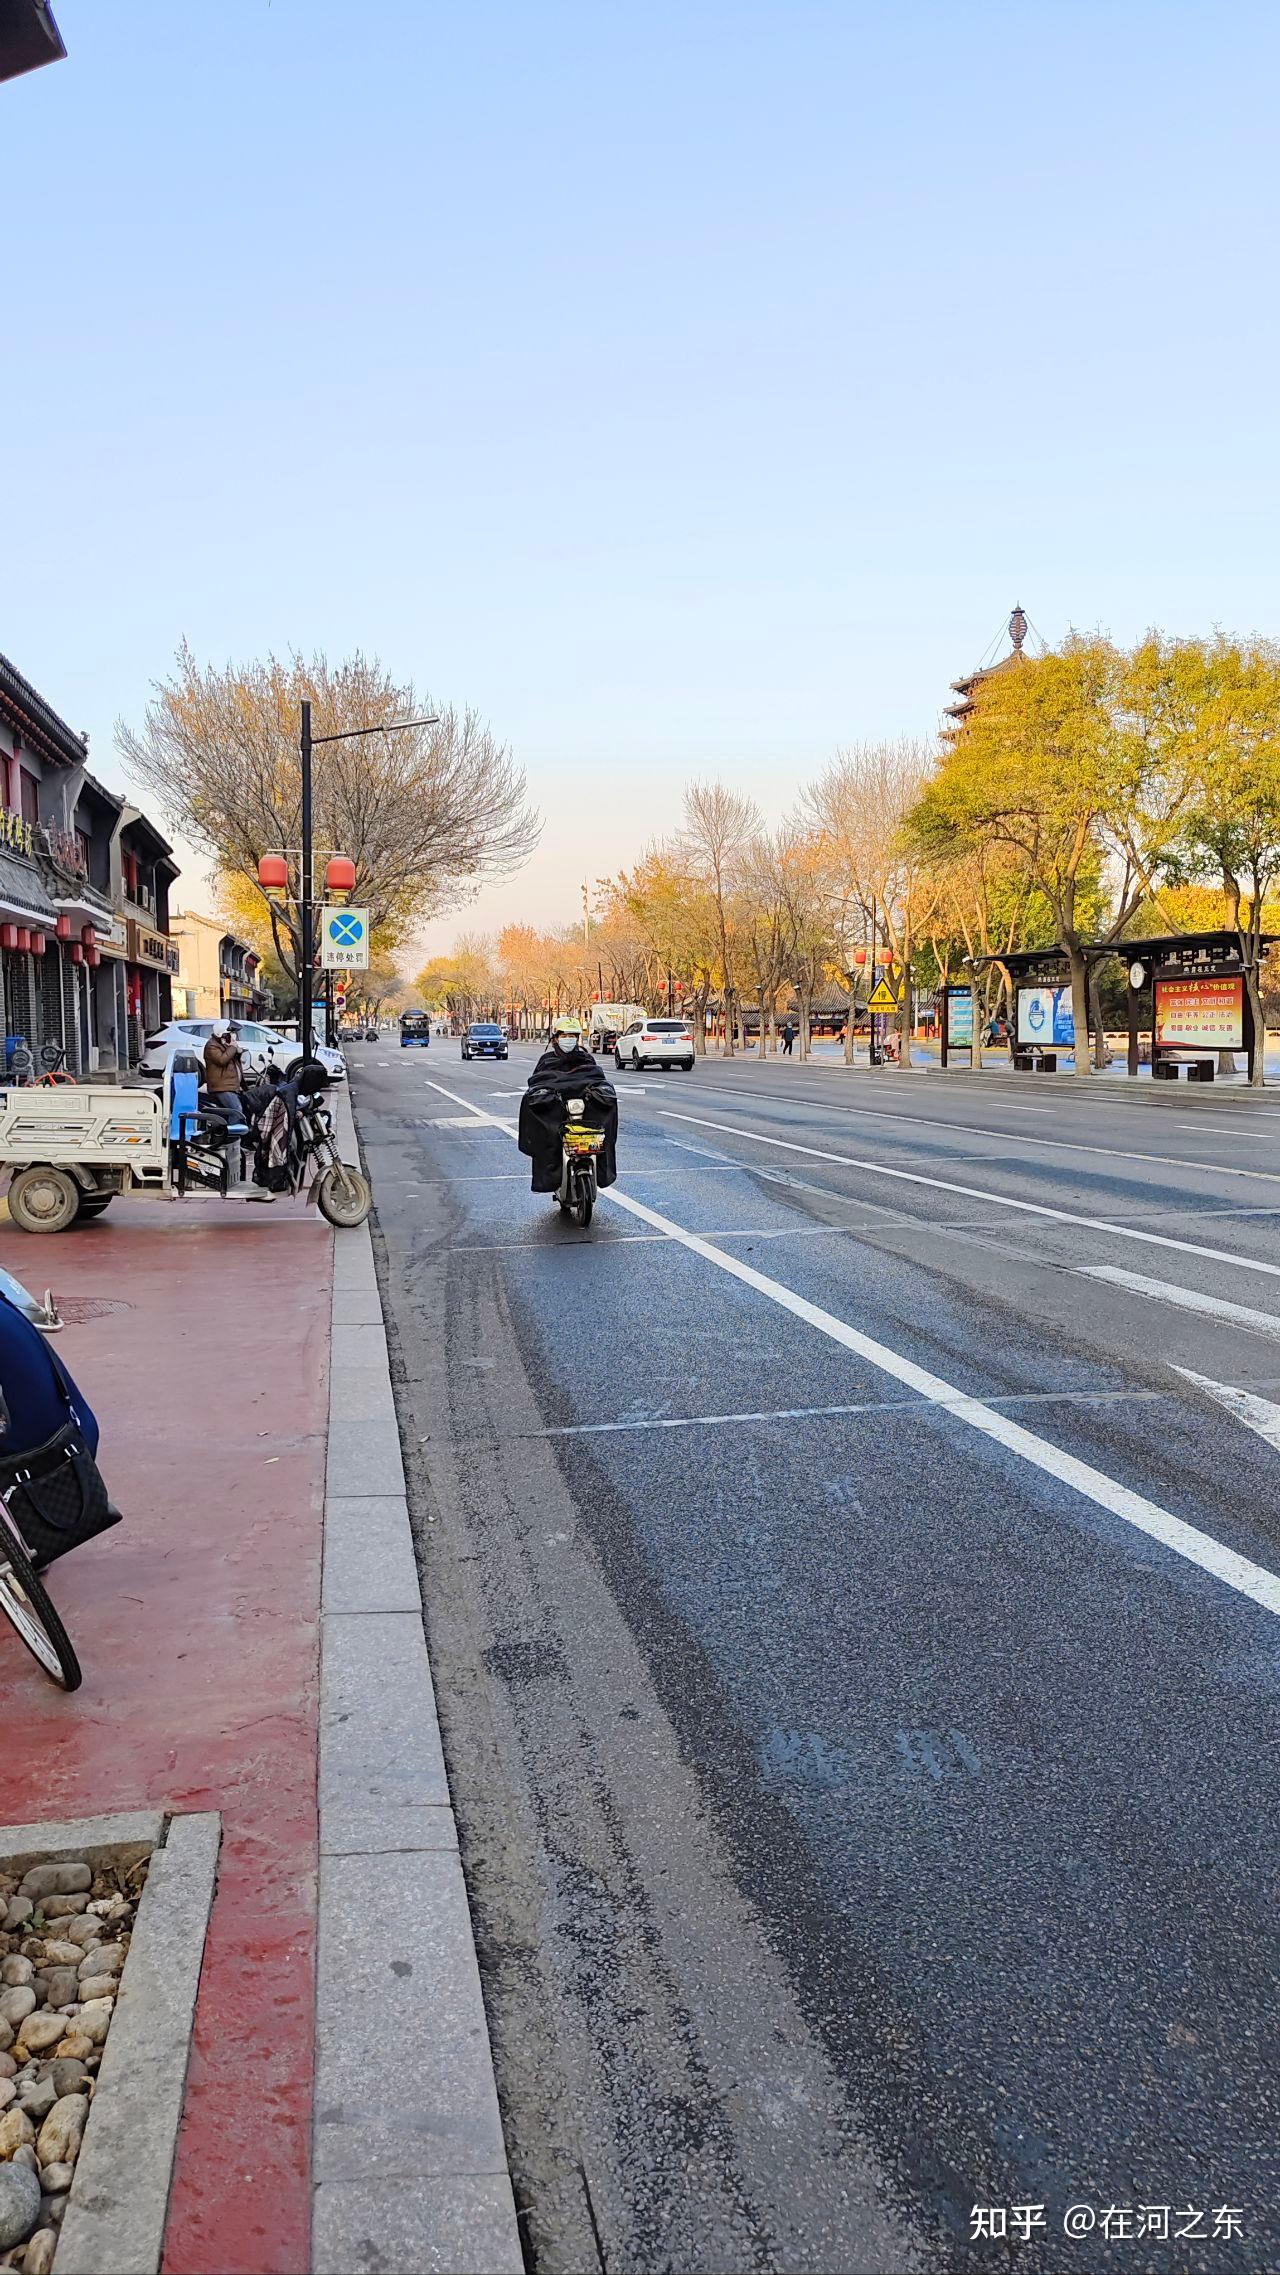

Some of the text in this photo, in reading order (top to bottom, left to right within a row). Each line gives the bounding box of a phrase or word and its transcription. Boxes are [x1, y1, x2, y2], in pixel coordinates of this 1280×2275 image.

[326, 951, 364, 963] 违停处罚
[1201, 997, 1217, 1006] 文明
[1218, 997, 1234, 1005] 和谐
[1185, 1011, 1199, 1019] 平等
